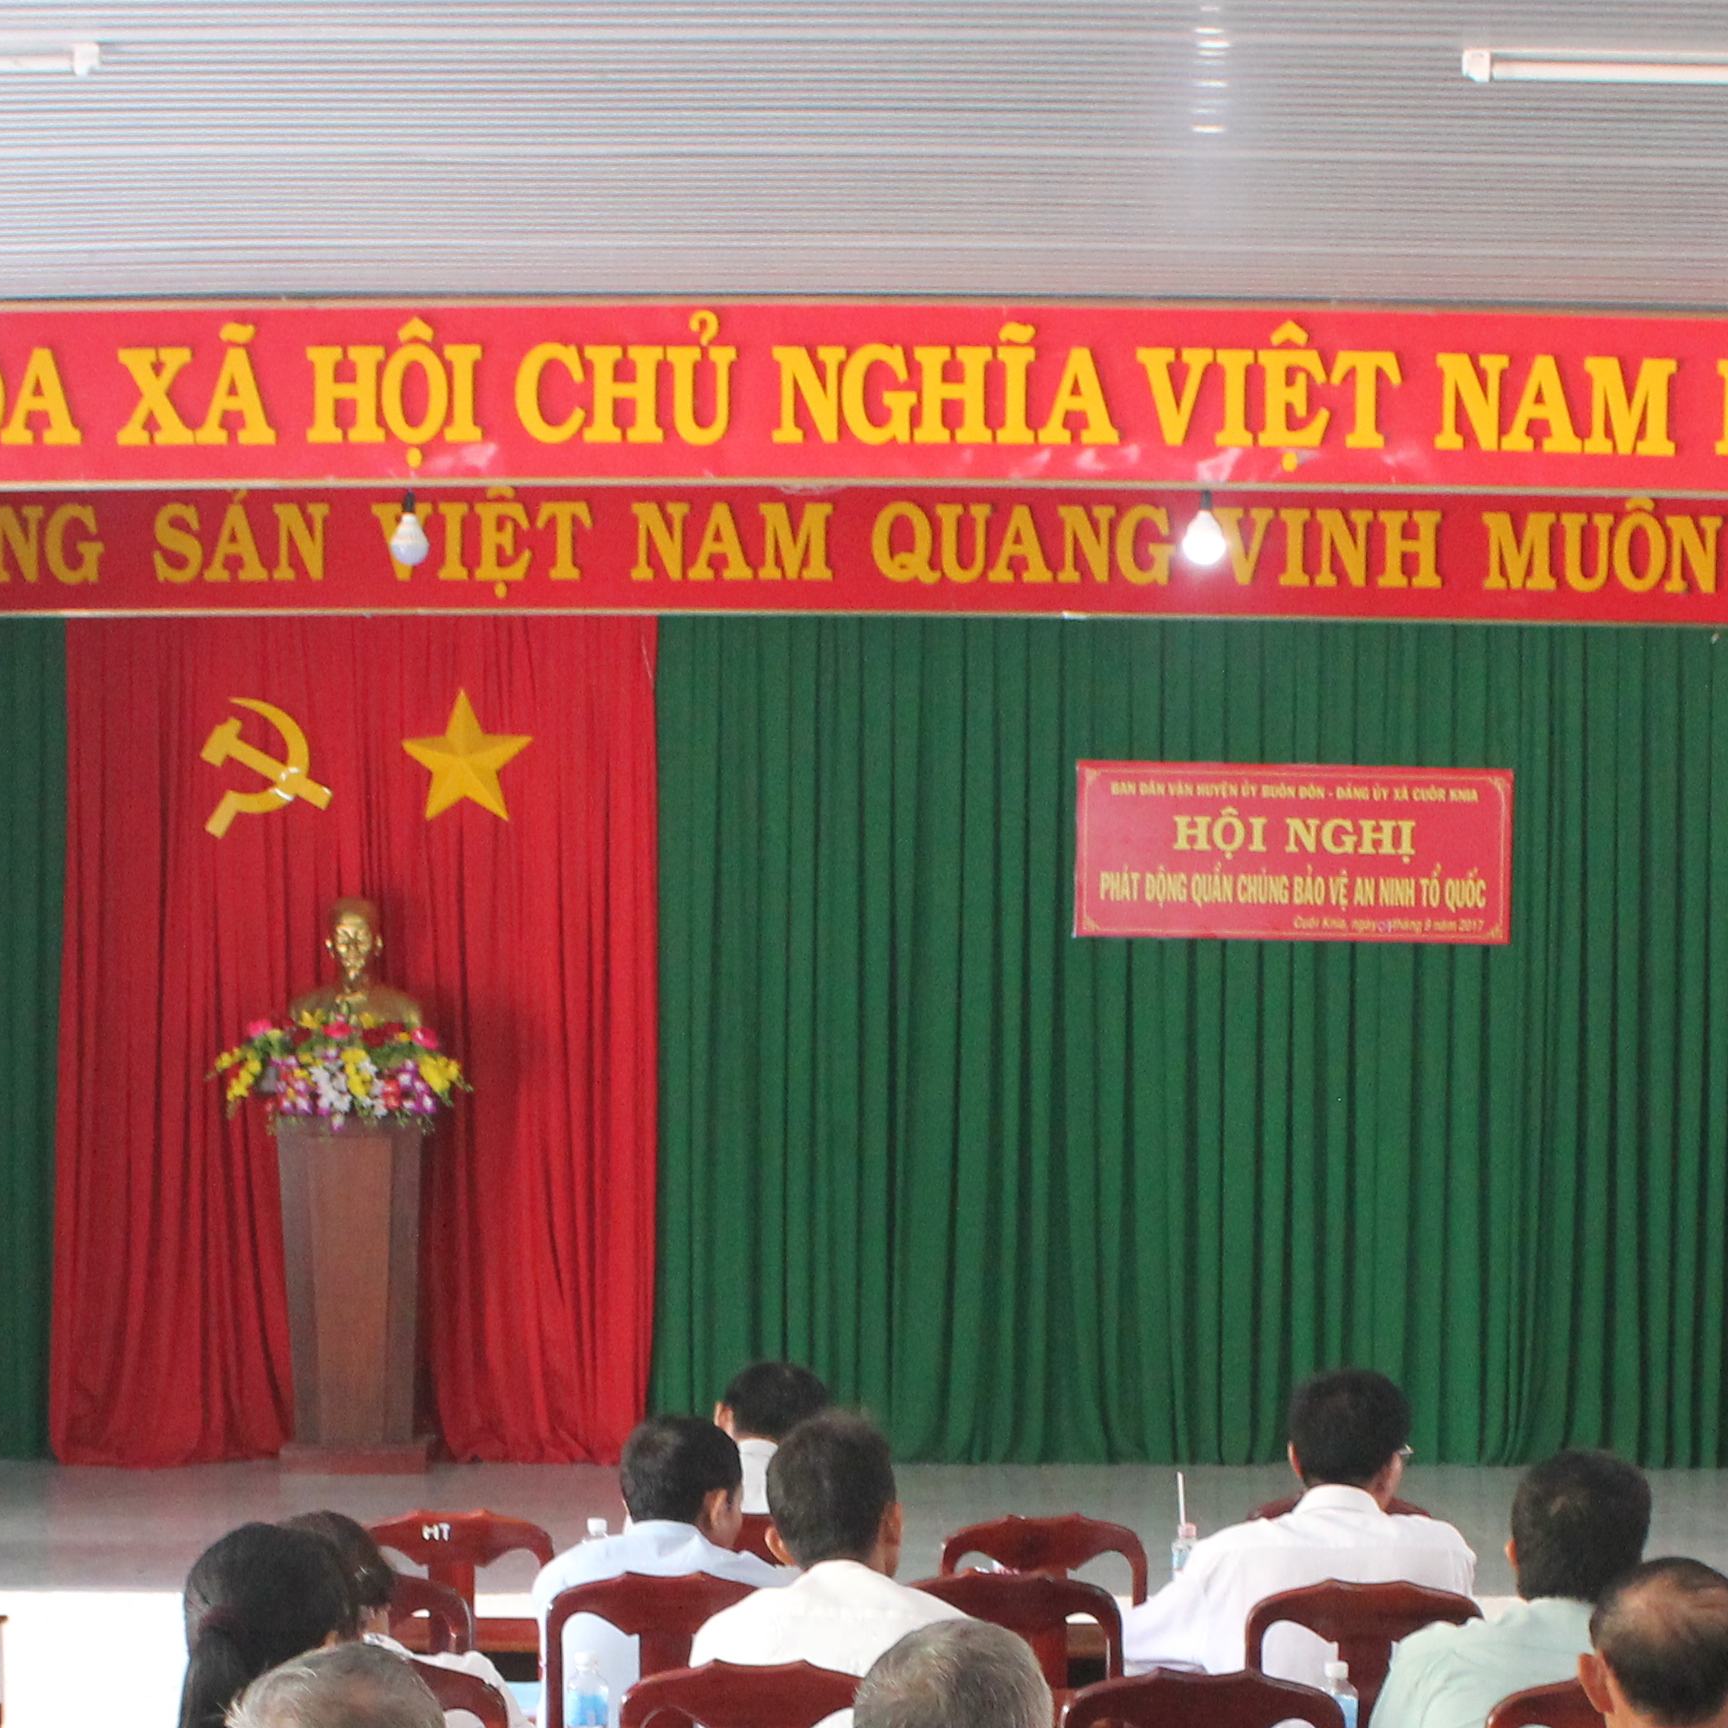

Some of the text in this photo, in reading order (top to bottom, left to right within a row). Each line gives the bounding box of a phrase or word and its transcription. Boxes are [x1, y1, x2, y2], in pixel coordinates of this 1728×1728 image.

[118, 322, 277, 446] XÃ
[307, 318, 483, 469] HỘI
[515, 310, 737, 446] CHỦ
[772, 322, 1119, 445] NGHĨA
[1137, 321, 1402, 472] VIỆT
[1435, 353, 1677, 456] NAM
[631, 502, 833, 581] NAM
[872, 501, 1169, 585] QUANG
[1216, 508, 1442, 588] VINH
[1483, 497, 1721, 593] MUÔN
[1174, 806, 1416, 863] HỘI NGHỊ
[1100, 862, 1487, 912] PHÁT ĐỘNG QUẦN CHÚNG BẢO VỆ AN NINH TỔ QUỐC
[422, 1522, 451, 1541] HT
